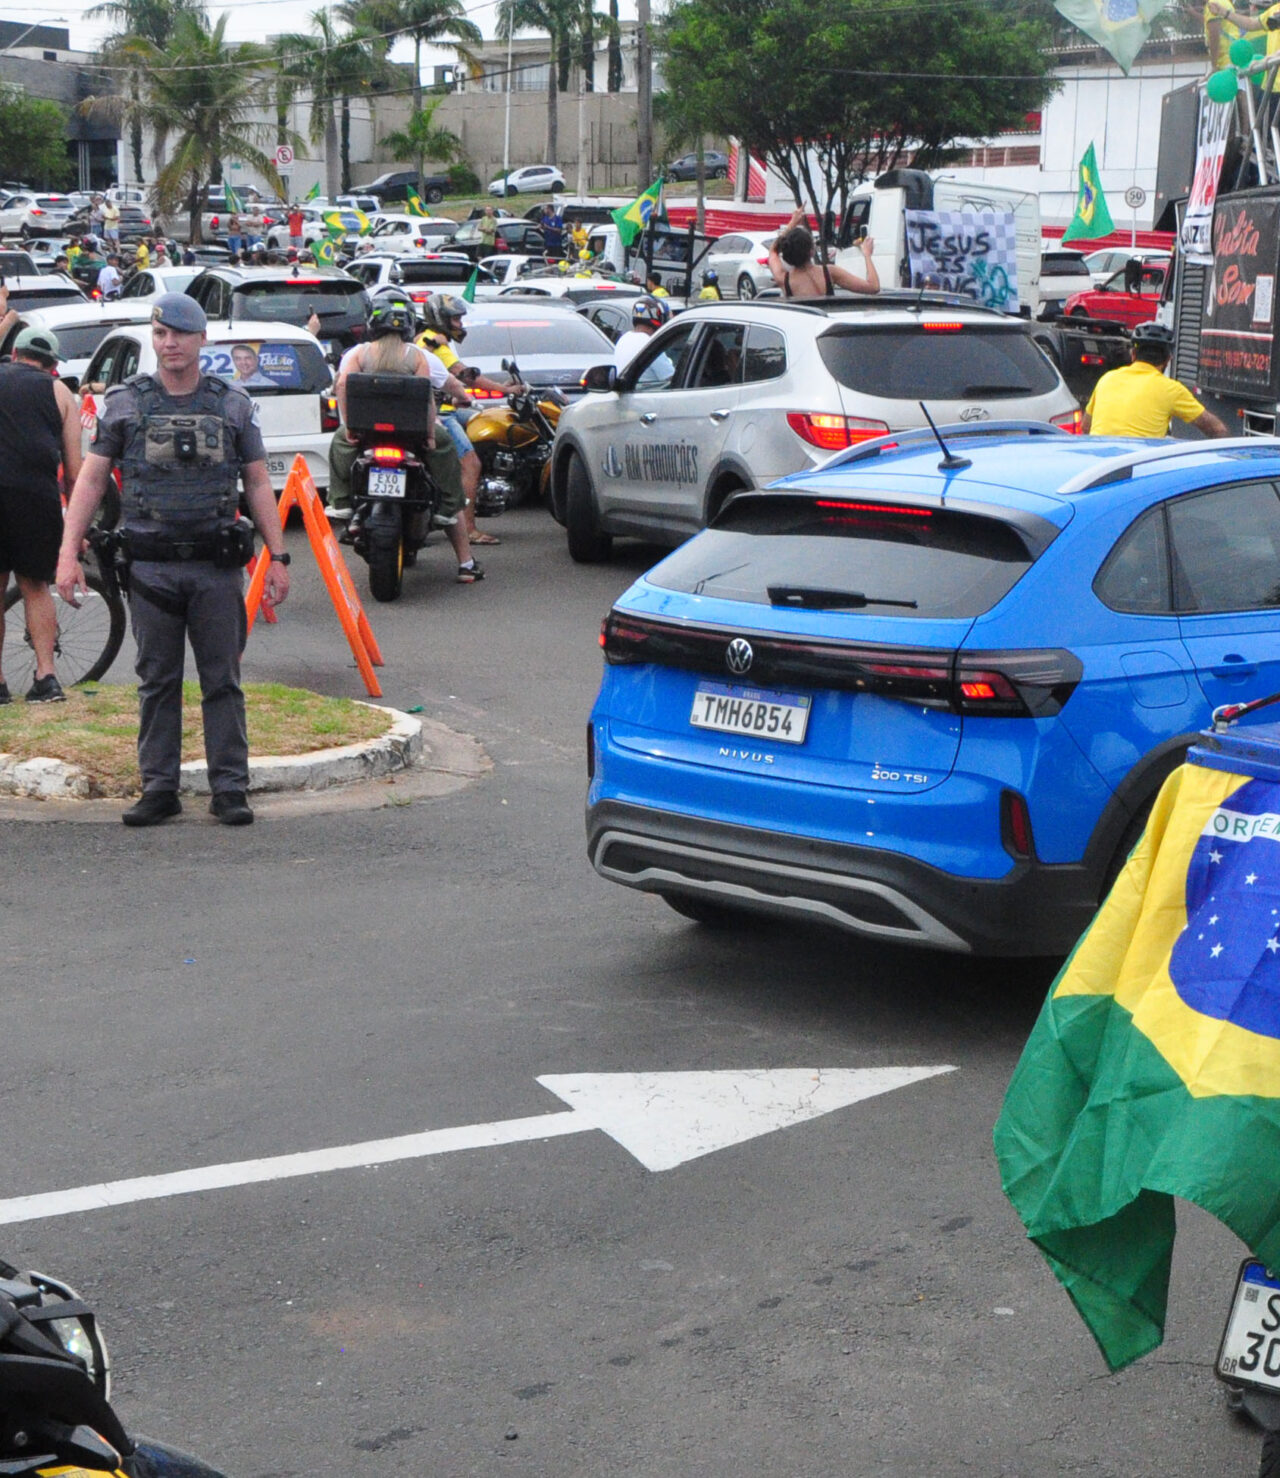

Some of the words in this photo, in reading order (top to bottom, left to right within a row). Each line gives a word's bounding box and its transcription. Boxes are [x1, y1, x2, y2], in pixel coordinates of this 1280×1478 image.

[1129, 190, 1143, 201] 50
[908, 220, 990, 256] JESUS
[1214, 210, 1260, 257] halita
[934, 256, 966, 273] IS
[200, 353, 234, 374] 22
[624, 443, 642, 480] RM
[374, 483, 401, 495] 2J24
[704, 695, 793, 736] TMH6B54
[718, 747, 775, 765] NIVUS
[871, 769, 901, 781] 200
[903, 773, 928, 784] TSI
[1222, 1356, 1239, 1374] BR
